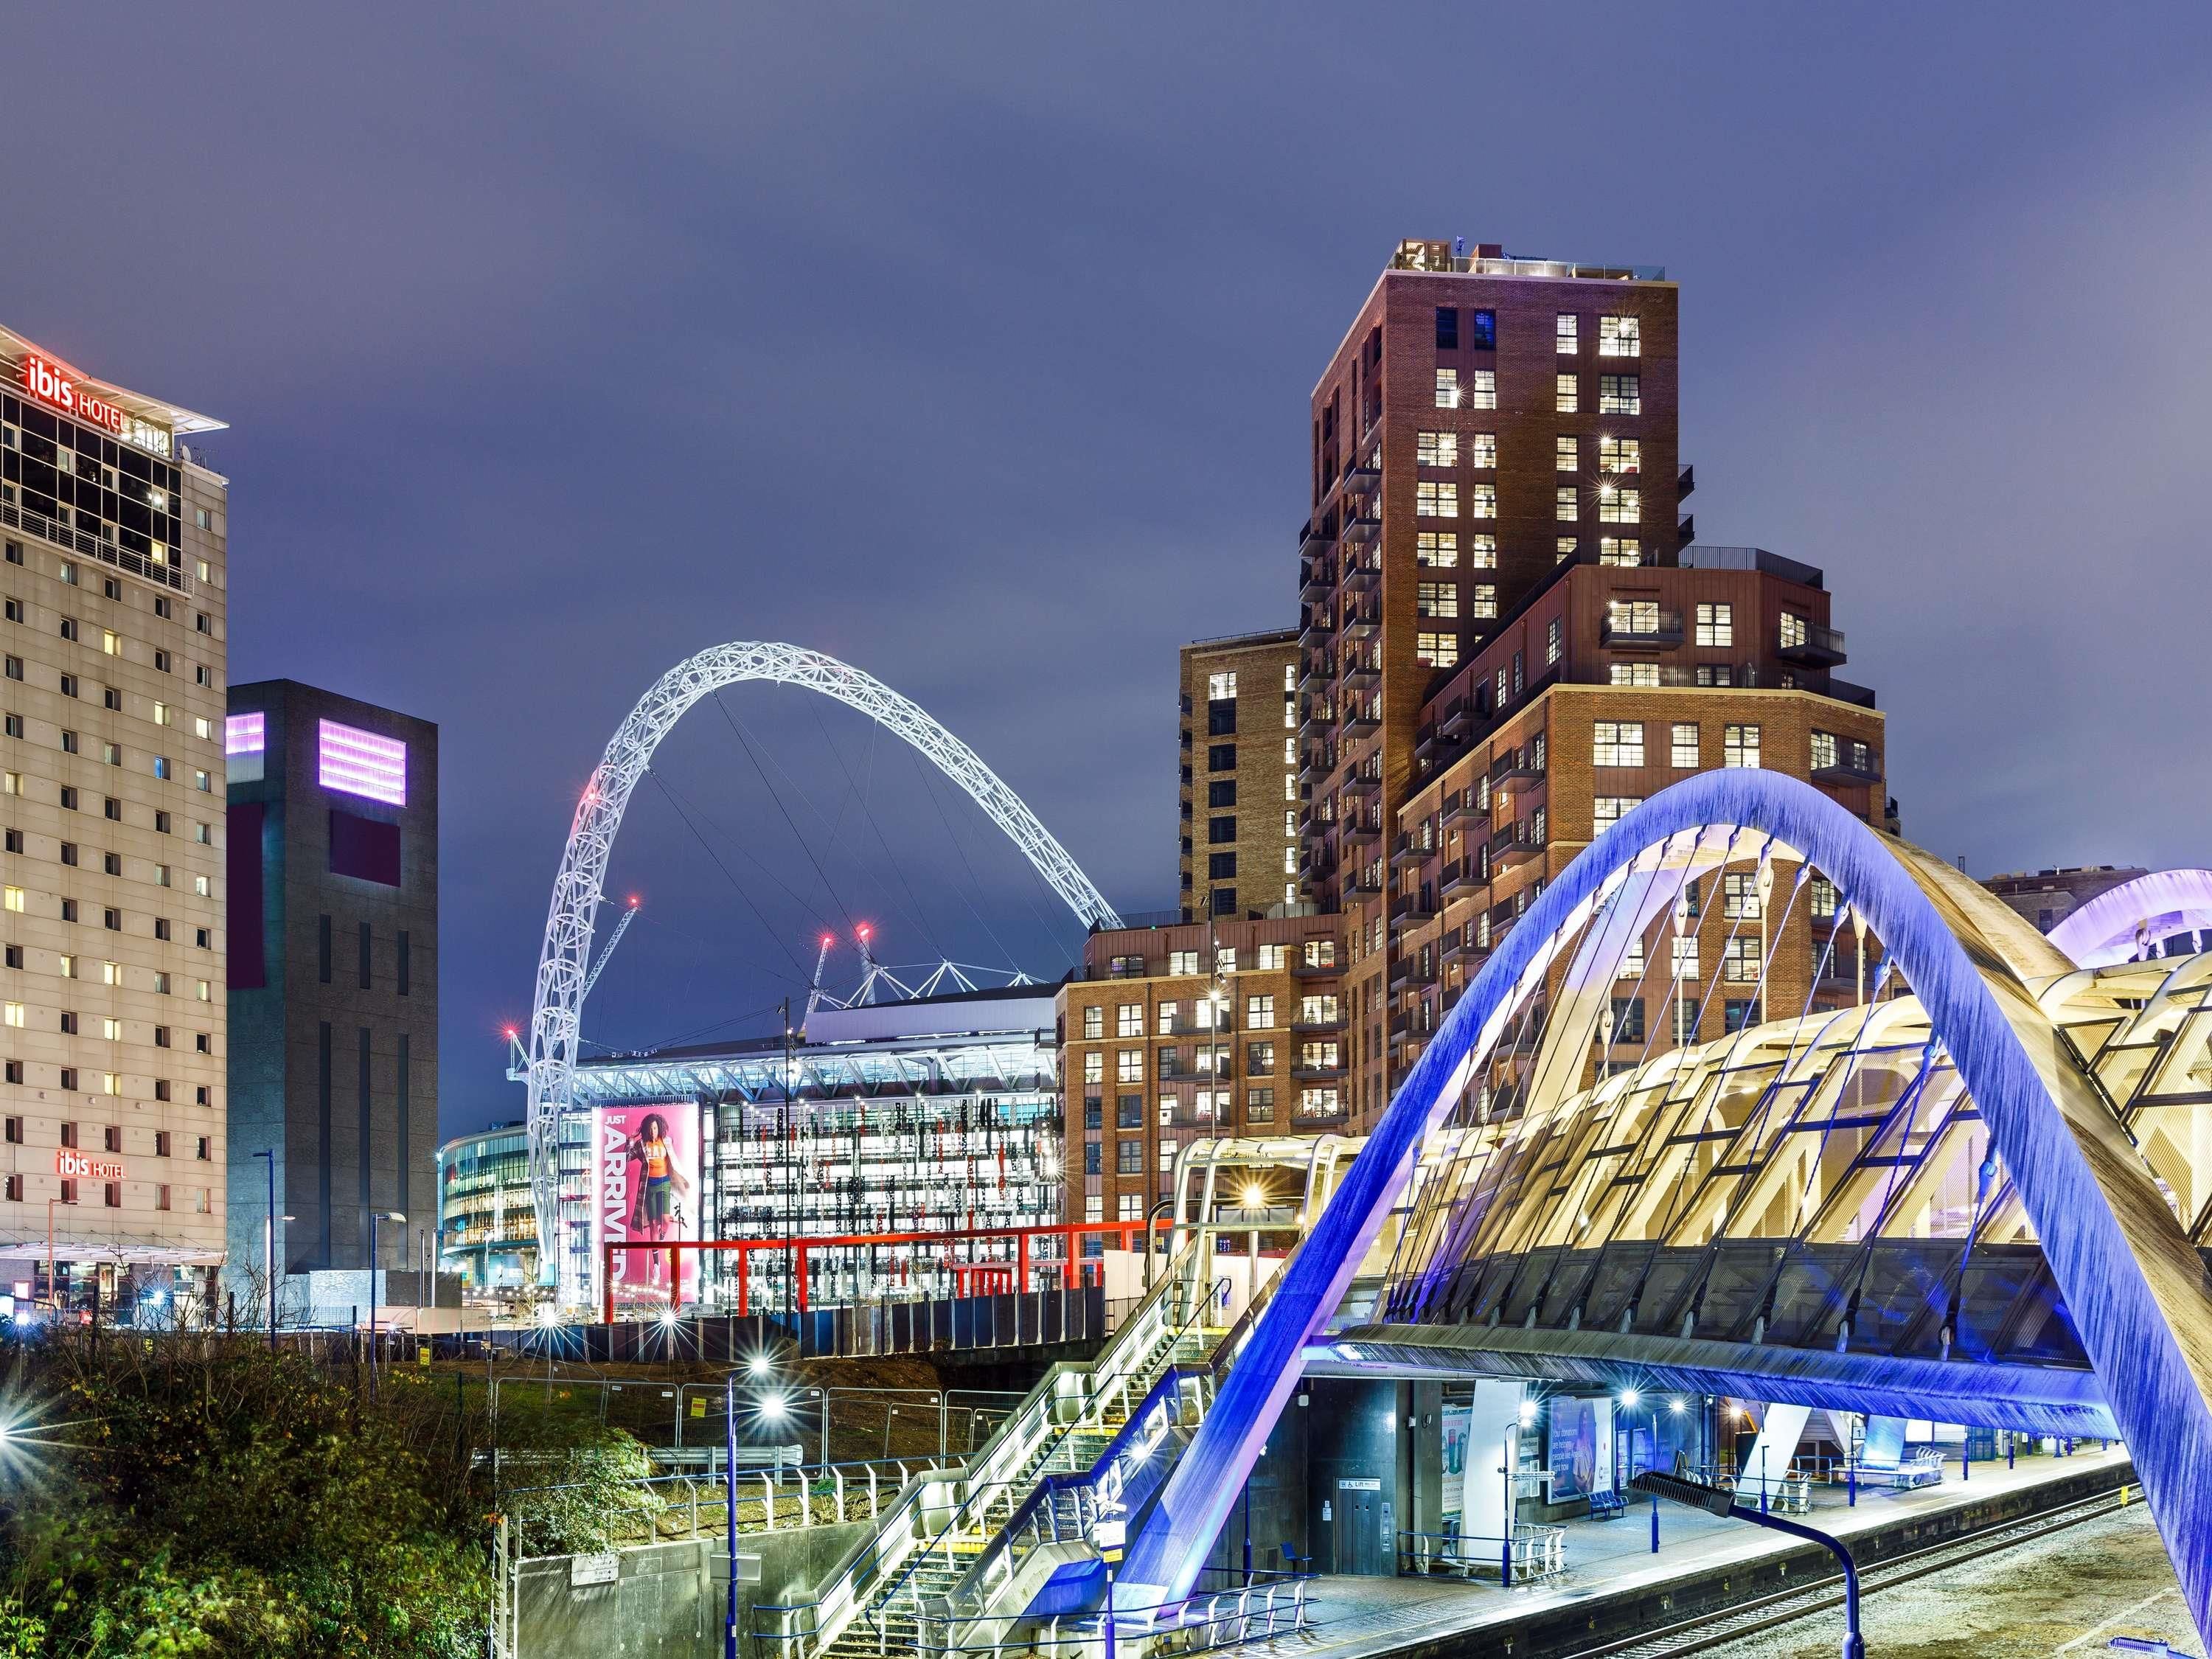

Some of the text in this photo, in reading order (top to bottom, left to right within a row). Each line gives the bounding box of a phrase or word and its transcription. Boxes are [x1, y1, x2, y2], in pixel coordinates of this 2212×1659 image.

[29, 357, 126, 432] ibis HOTEL
[605, 1115, 627, 1124] JUST
[59, 1151, 126, 1178] ibis HOTEL
[605, 1125, 626, 1281] ARRIVED
